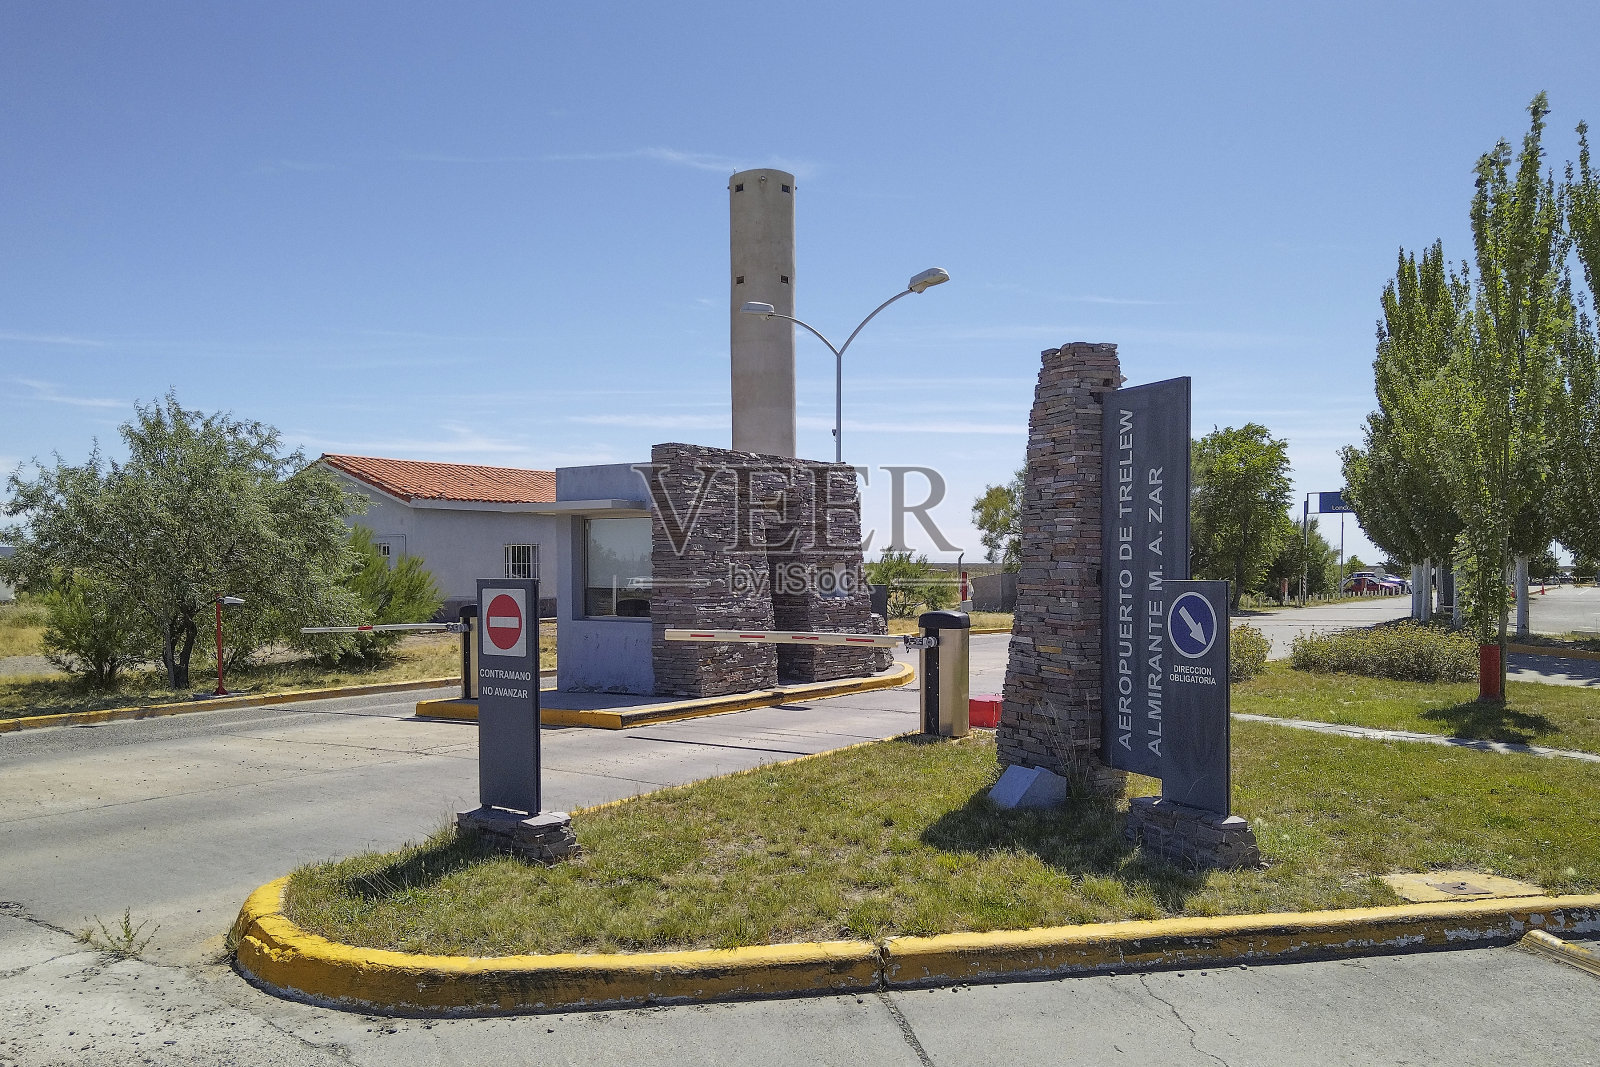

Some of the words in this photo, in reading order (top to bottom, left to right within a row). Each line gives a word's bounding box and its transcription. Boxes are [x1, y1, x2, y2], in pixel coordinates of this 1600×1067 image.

[1119, 409, 1133, 519] TRELEW
[1148, 466, 1163, 524] ZAR
[1119, 526, 1133, 561] DE
[1148, 530, 1163, 556] A.
[1148, 564, 1163, 591] M.
[1118, 569, 1133, 751] AEROPUERTO
[1173, 664, 1212, 676] DIRECCION
[480, 668, 531, 681] CONTRAMANO
[1148, 600, 1163, 757] ALMIRANTE
[1170, 673, 1217, 686] OBLIGATORIA
[482, 686, 493, 696] NO
[494, 687, 528, 699] AVANZAR
